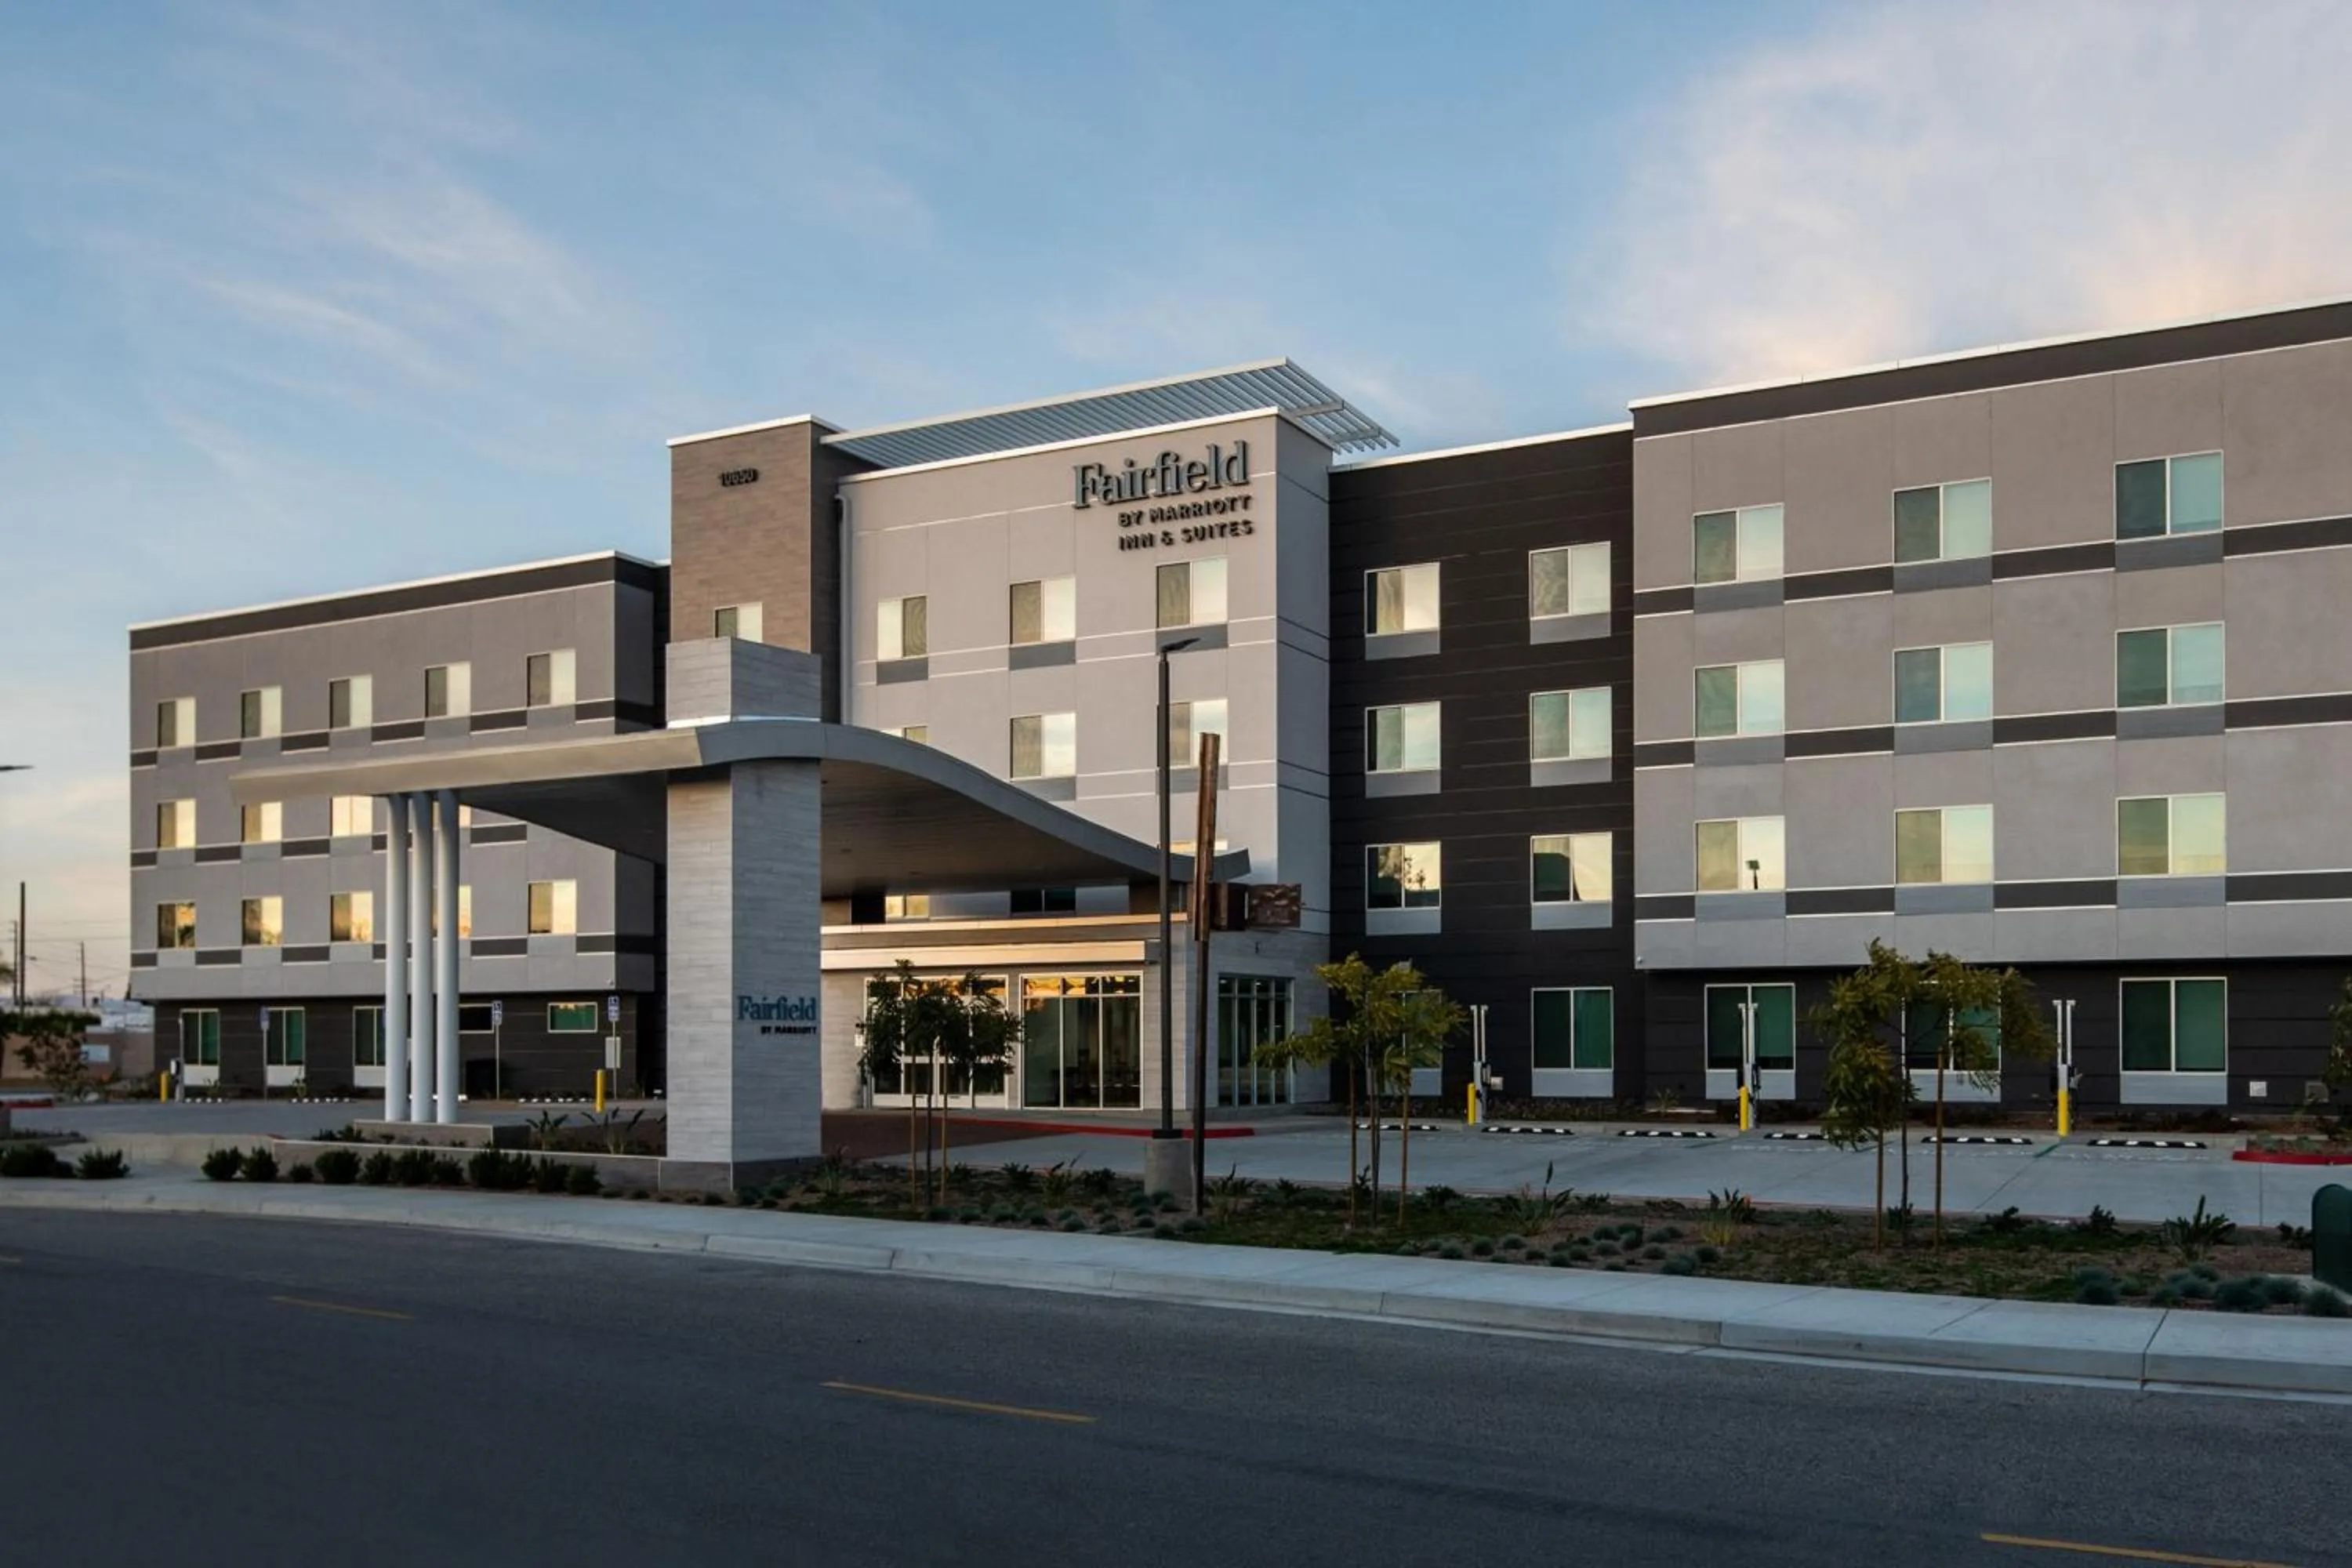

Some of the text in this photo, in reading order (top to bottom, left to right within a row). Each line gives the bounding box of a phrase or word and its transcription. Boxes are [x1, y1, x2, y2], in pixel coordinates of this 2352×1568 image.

[1073, 439, 1251, 510] Fairfield
[1117, 495, 1254, 528] BY MARRIOTT
[1117, 519, 1255, 551] INN & SUITES
[737, 995, 817, 1021] Fairfield
